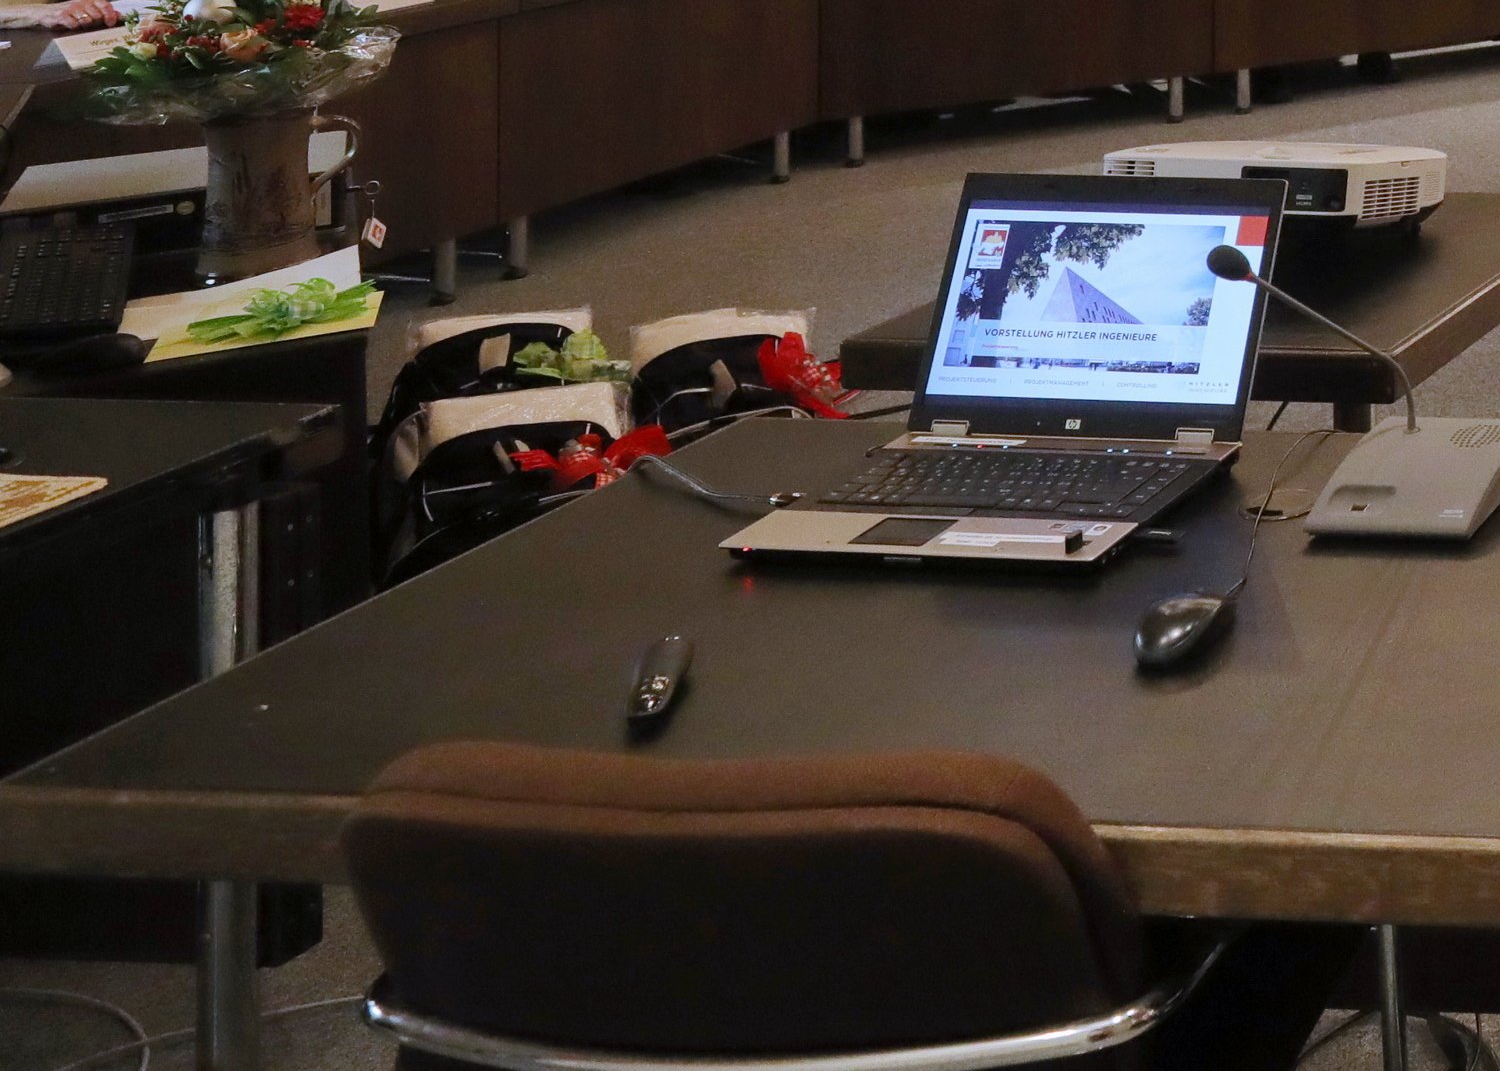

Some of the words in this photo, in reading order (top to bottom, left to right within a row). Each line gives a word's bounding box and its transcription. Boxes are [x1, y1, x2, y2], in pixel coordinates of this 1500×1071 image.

[984, 328, 1055, 339] VORSTELLUNG
[1056, 330, 1097, 340] HITZLER
[1098, 331, 1158, 342] INGENIEURE
